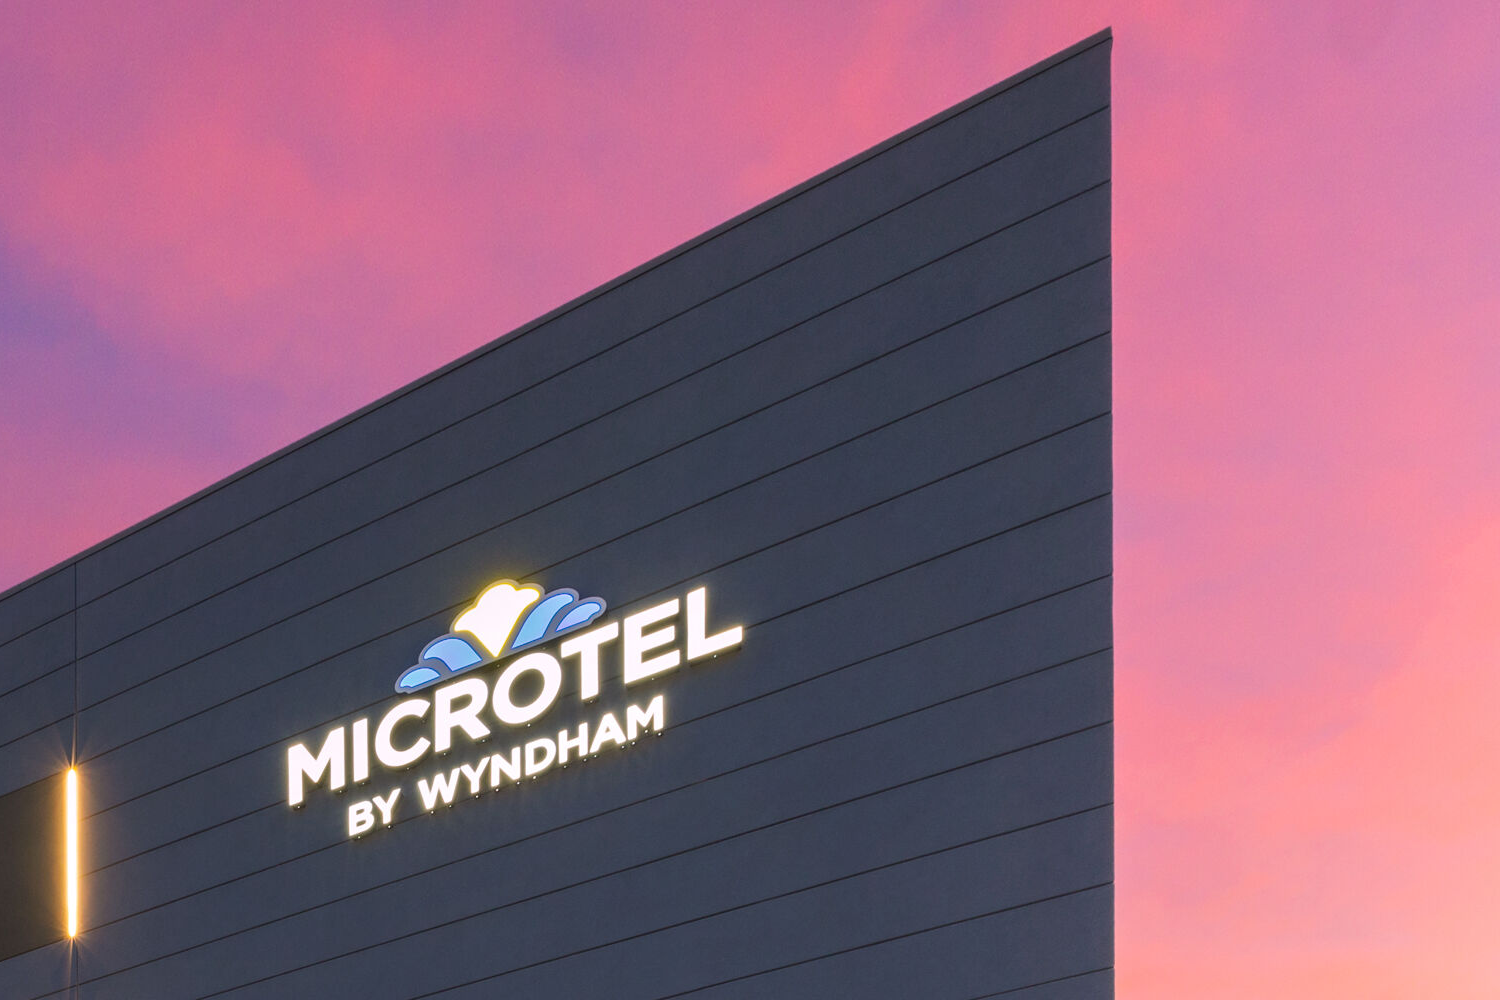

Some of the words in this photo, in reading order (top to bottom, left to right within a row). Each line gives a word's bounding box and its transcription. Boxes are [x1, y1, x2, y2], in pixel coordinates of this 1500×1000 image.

[287, 586, 744, 807] MICROTEL
[347, 789, 402, 837] BY
[417, 695, 665, 811] WYNDHAM
